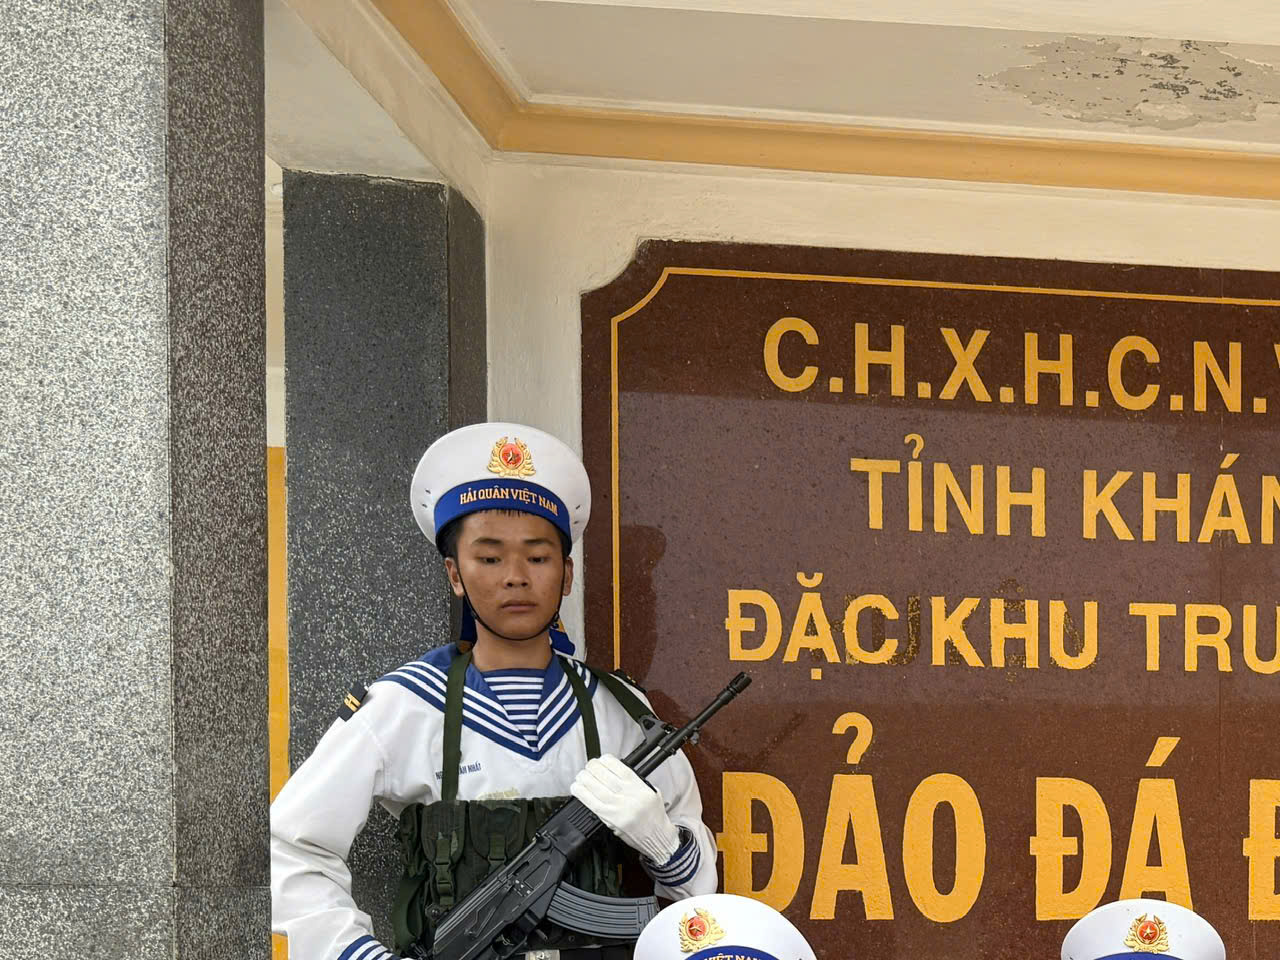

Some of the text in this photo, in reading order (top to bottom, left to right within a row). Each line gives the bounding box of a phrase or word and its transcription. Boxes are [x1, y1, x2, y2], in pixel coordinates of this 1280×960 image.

[459, 485, 558, 516] HẢI QUÂN VIỆT NAM
[850, 433, 1046, 538] TỈNH
[724, 571, 901, 681] ĐẶC
[930, 595, 1099, 671] KHU
[715, 711, 987, 923] ĐẢO
[1029, 736, 1194, 922] ĐÁ
